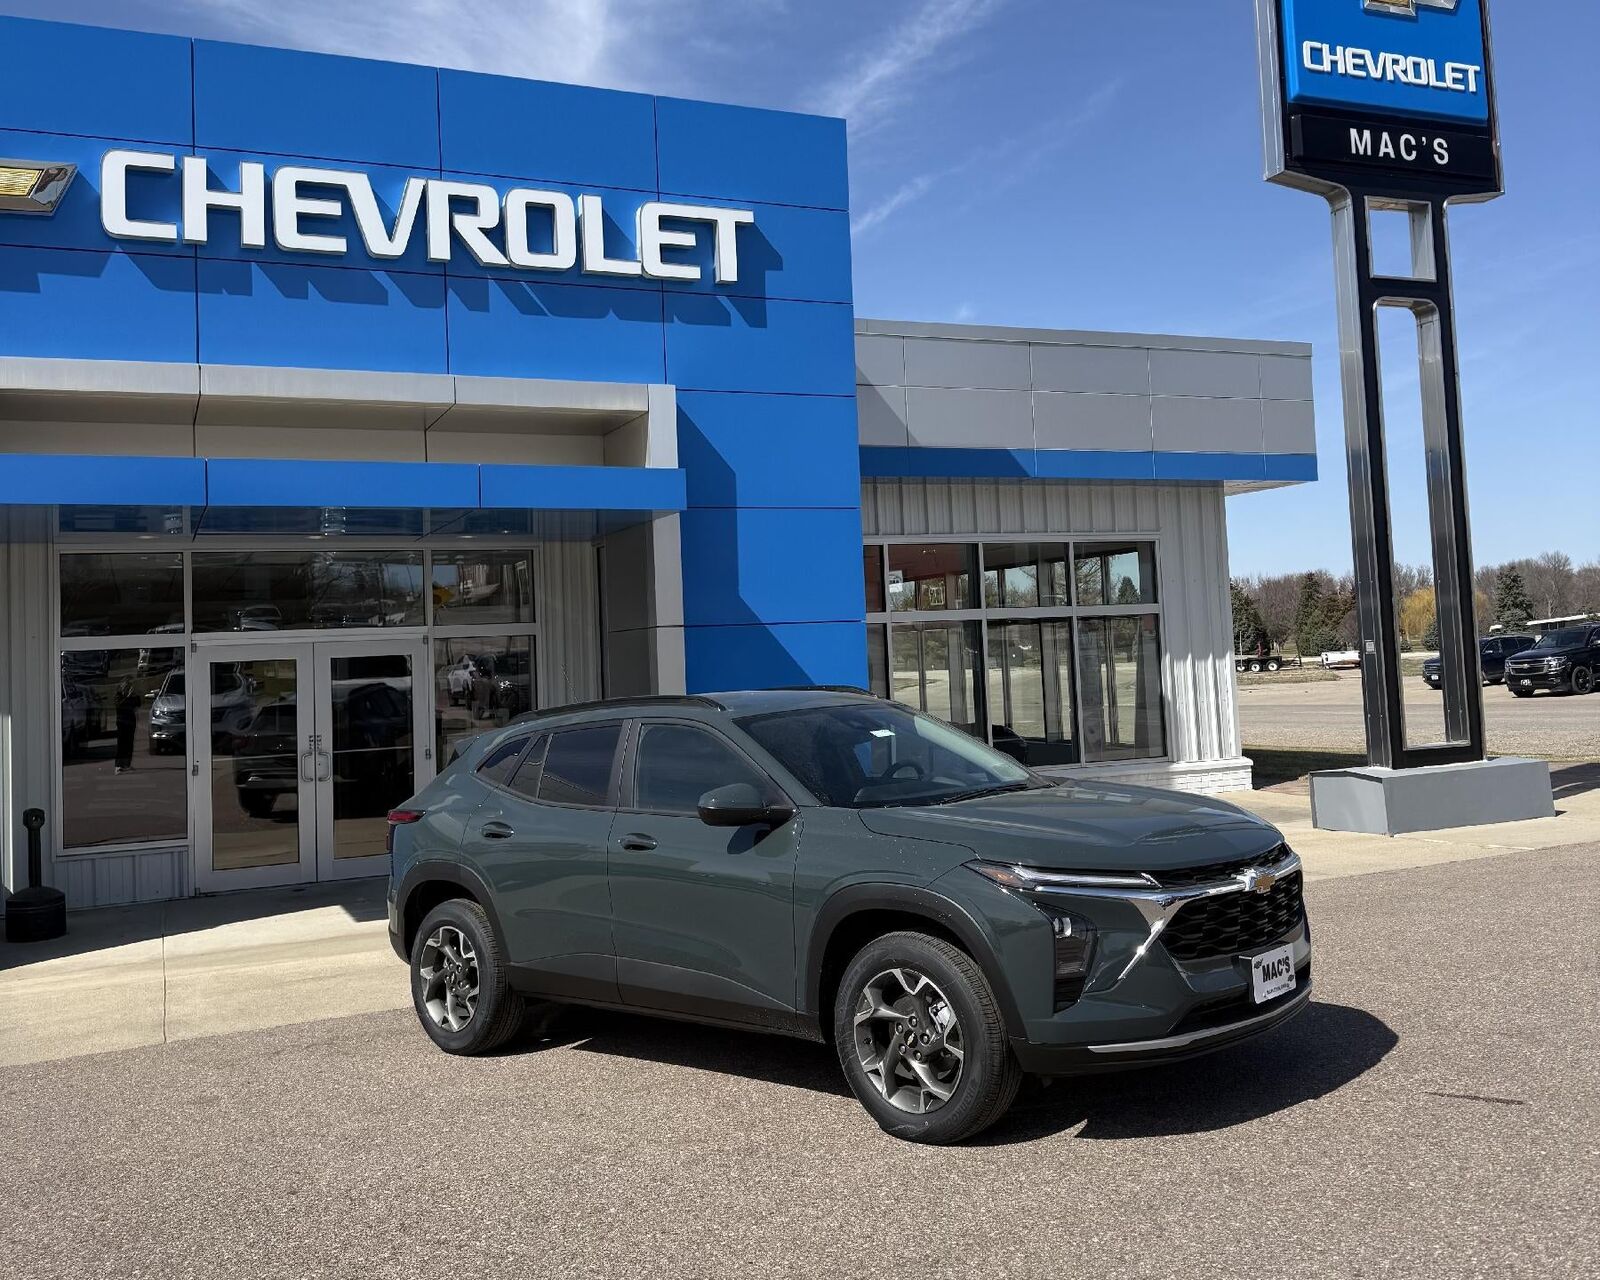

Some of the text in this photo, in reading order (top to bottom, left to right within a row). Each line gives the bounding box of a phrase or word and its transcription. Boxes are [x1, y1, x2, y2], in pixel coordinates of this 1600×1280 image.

[1302, 40, 1480, 92] CHEVROLET
[1349, 128, 1449, 165] MAC'S
[100, 149, 754, 283] CHEVROLET
[1262, 956, 1290, 982] MAC'S
